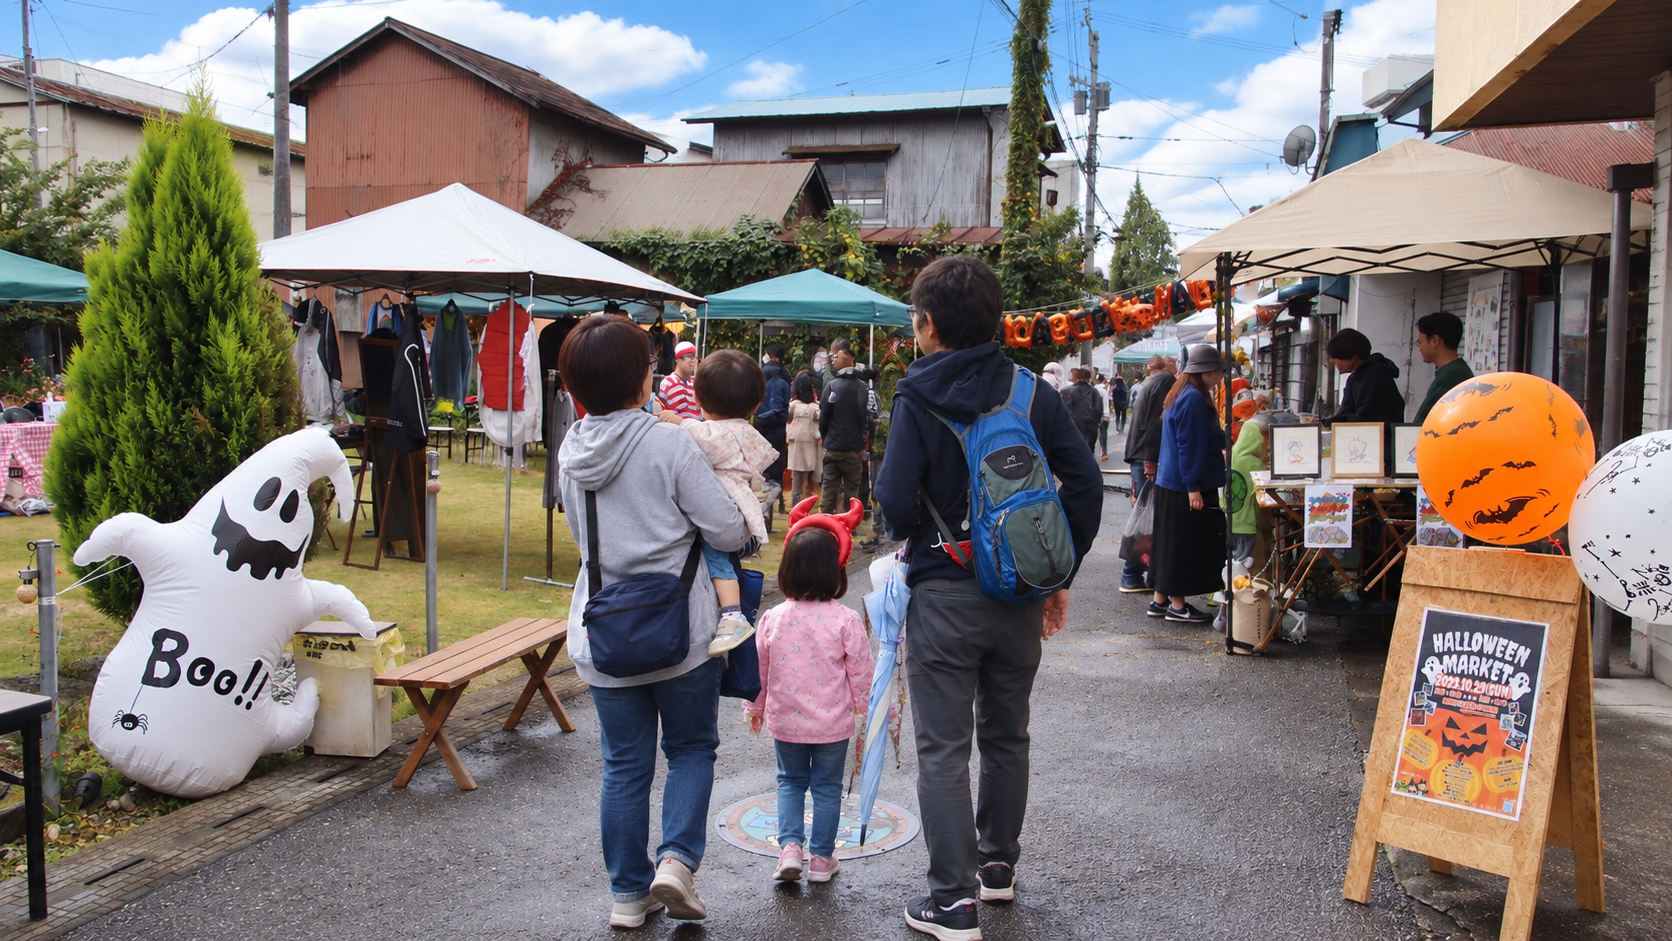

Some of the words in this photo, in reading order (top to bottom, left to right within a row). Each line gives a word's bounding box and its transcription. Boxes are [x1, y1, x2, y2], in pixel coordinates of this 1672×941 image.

[1433, 631, 1531, 667] HALLOWEEN
[141, 628, 269, 710] Boo!!
[1442, 654, 1514, 684] MARKET
